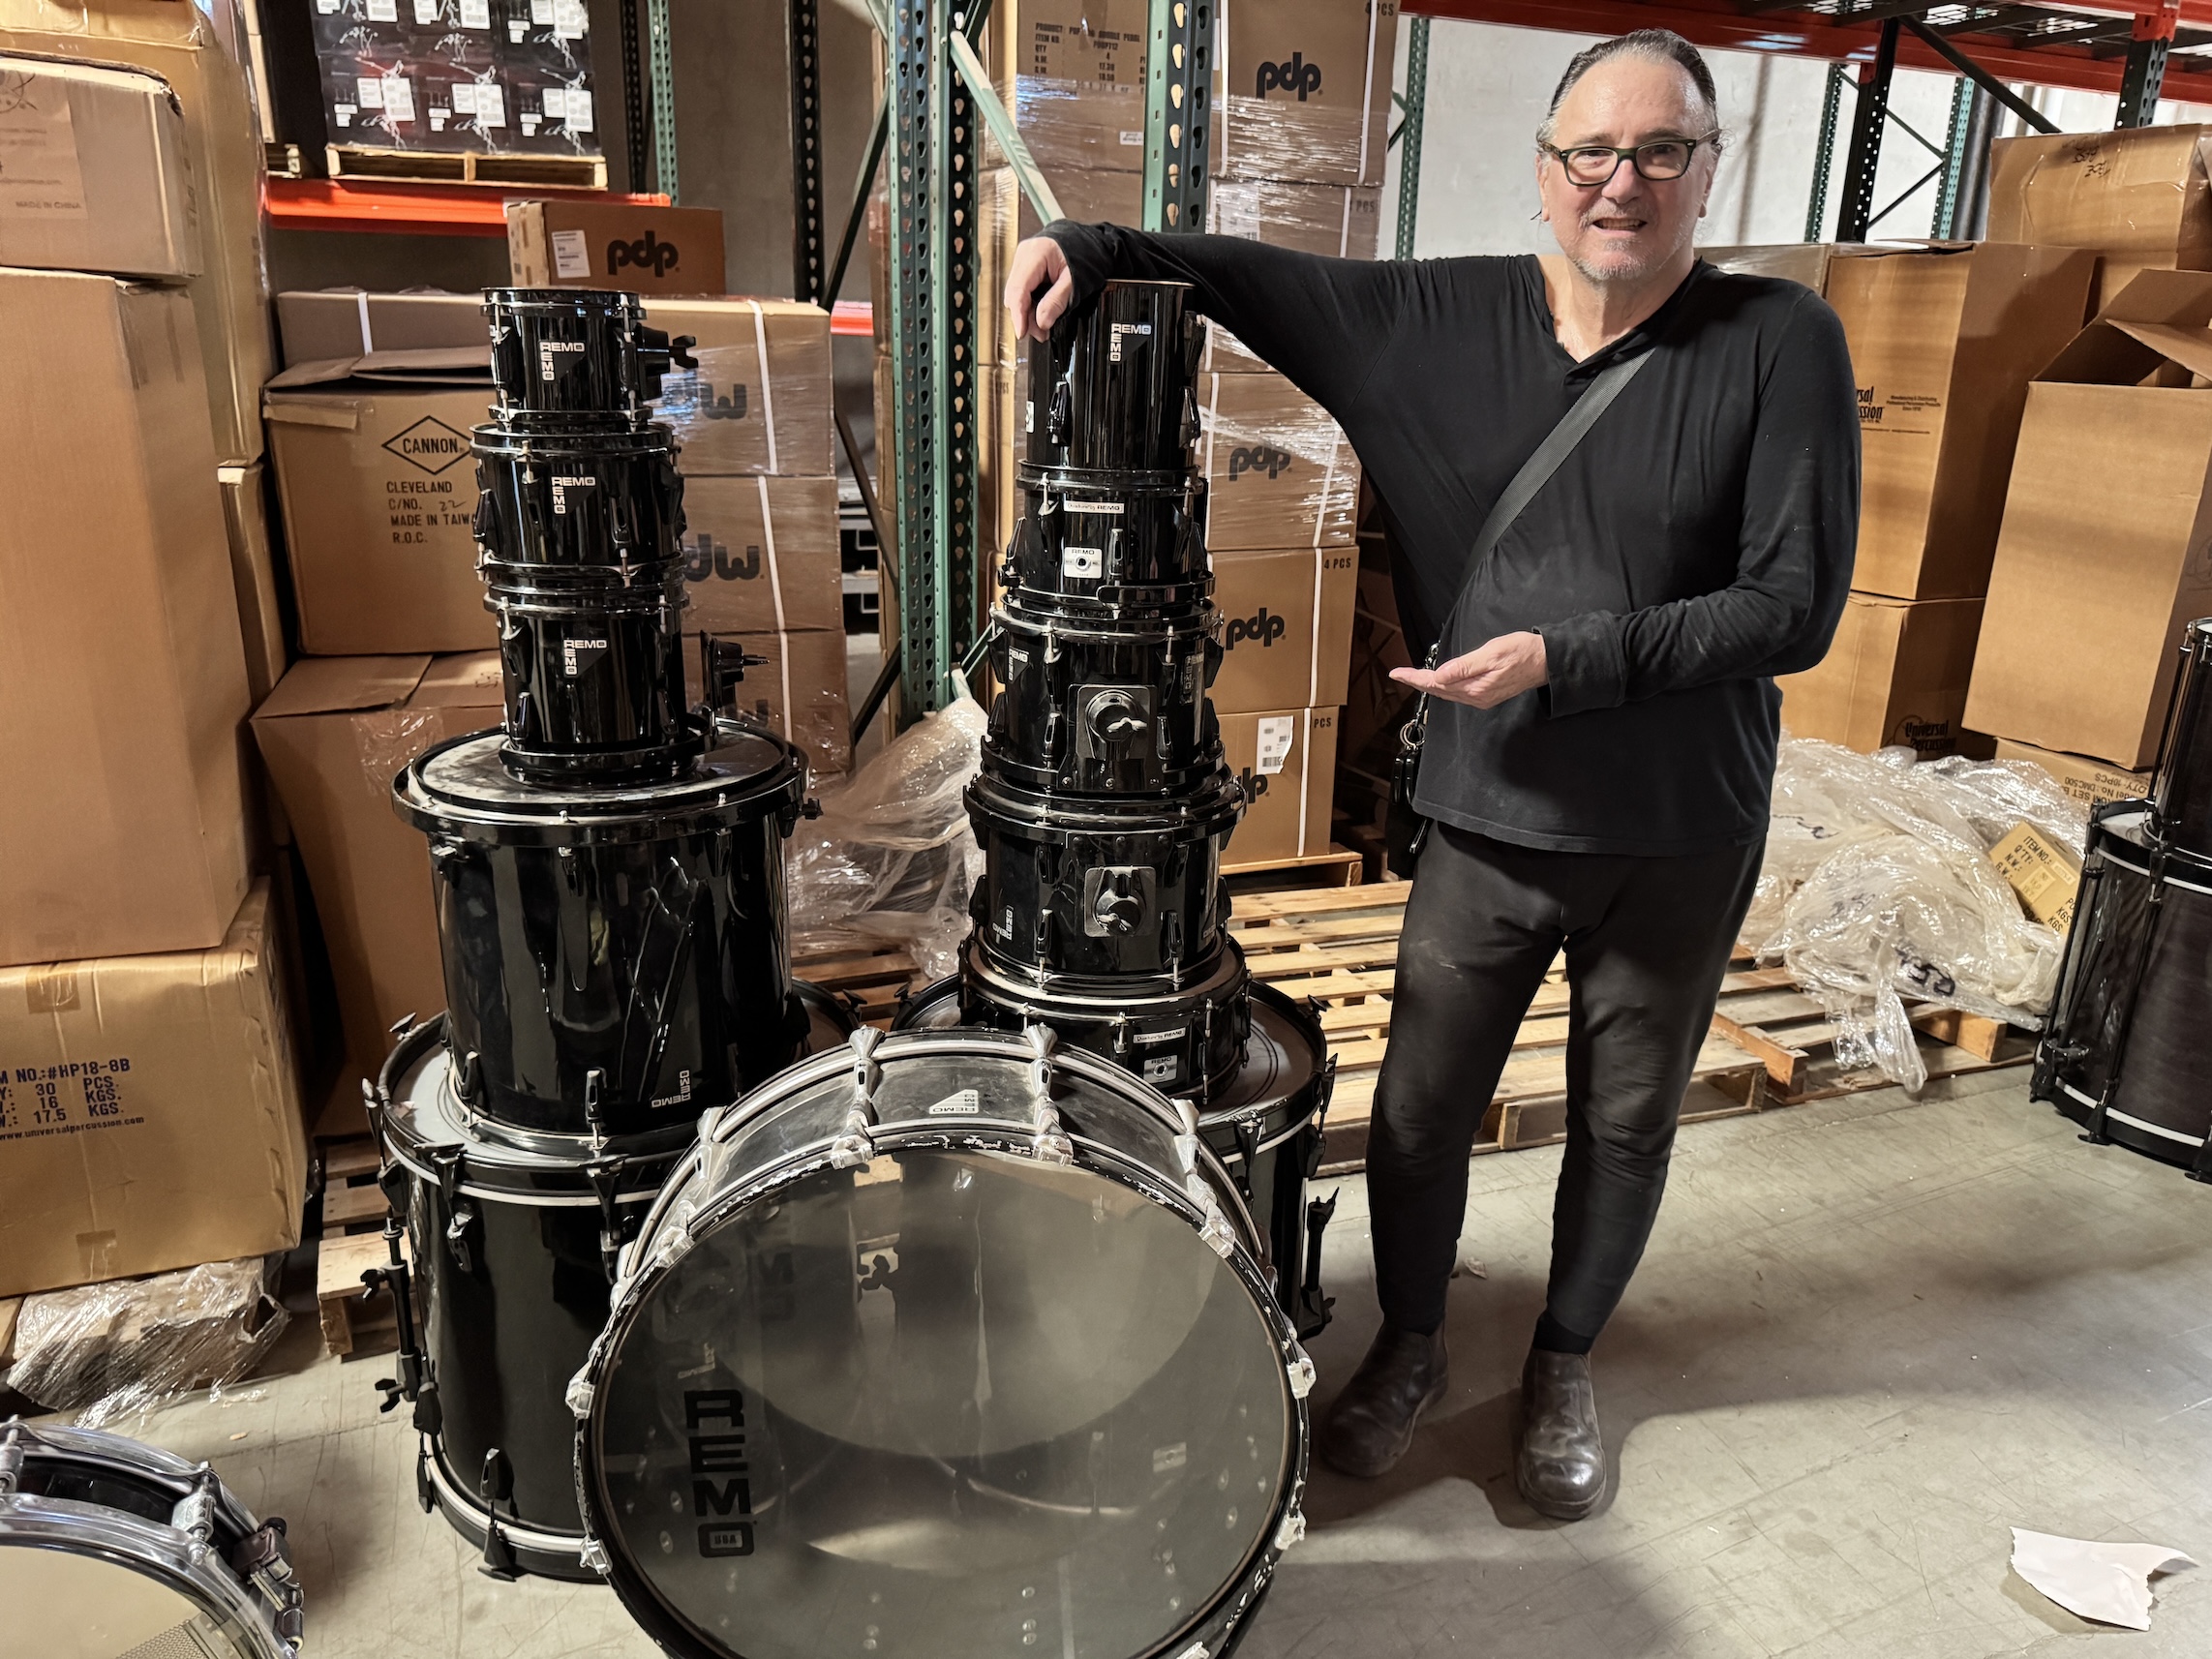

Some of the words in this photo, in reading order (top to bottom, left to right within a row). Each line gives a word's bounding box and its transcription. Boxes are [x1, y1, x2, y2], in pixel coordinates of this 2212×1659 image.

[1257, 52, 1321, 102] pdp
[607, 230, 679, 277] pdp
[1110, 323, 1151, 335] REMO
[539, 342, 585, 352] REMO
[1109, 323, 1122, 362] REMO
[539, 342, 555, 380] REMO
[403, 437, 458, 454] CANNON
[1229, 444, 1290, 481] pdp
[386, 481, 452, 493] CLEVELAND
[551, 476, 596, 486] REMO
[551, 476, 566, 514] REMO
[388, 498, 422, 510] C/NO.
[390, 515, 421, 527] MADE
[427, 515, 438, 526] IN
[443, 513, 475, 525] TAIW
[393, 532, 428, 543] R.O.C.
[683, 534, 760, 582] dw
[1324, 558, 1330, 569] 4
[1333, 558, 1351, 569] PCS
[1226, 607, 1286, 650] pdp
[563, 639, 607, 649] REMO
[563, 639, 578, 676] REMO
[1009, 647, 1028, 663] REMO
[1314, 718, 1331, 728] PCS
[2064, 776, 2096, 792] DMC500
[2072, 790, 2091, 801] SET
[2023, 836, 2040, 853] ITEM
[1151, 1056, 1172, 1065] REMO
[35, 1082, 56, 1096] 30
[680, 1069, 691, 1101] REMO
[40, 1096, 59, 1109] 16
[85, 1089, 122, 1103] KGS.
[651, 1093, 691, 1108] REMO
[33, 1108, 67, 1124] 17.5
[683, 1389, 755, 1558] REMO
